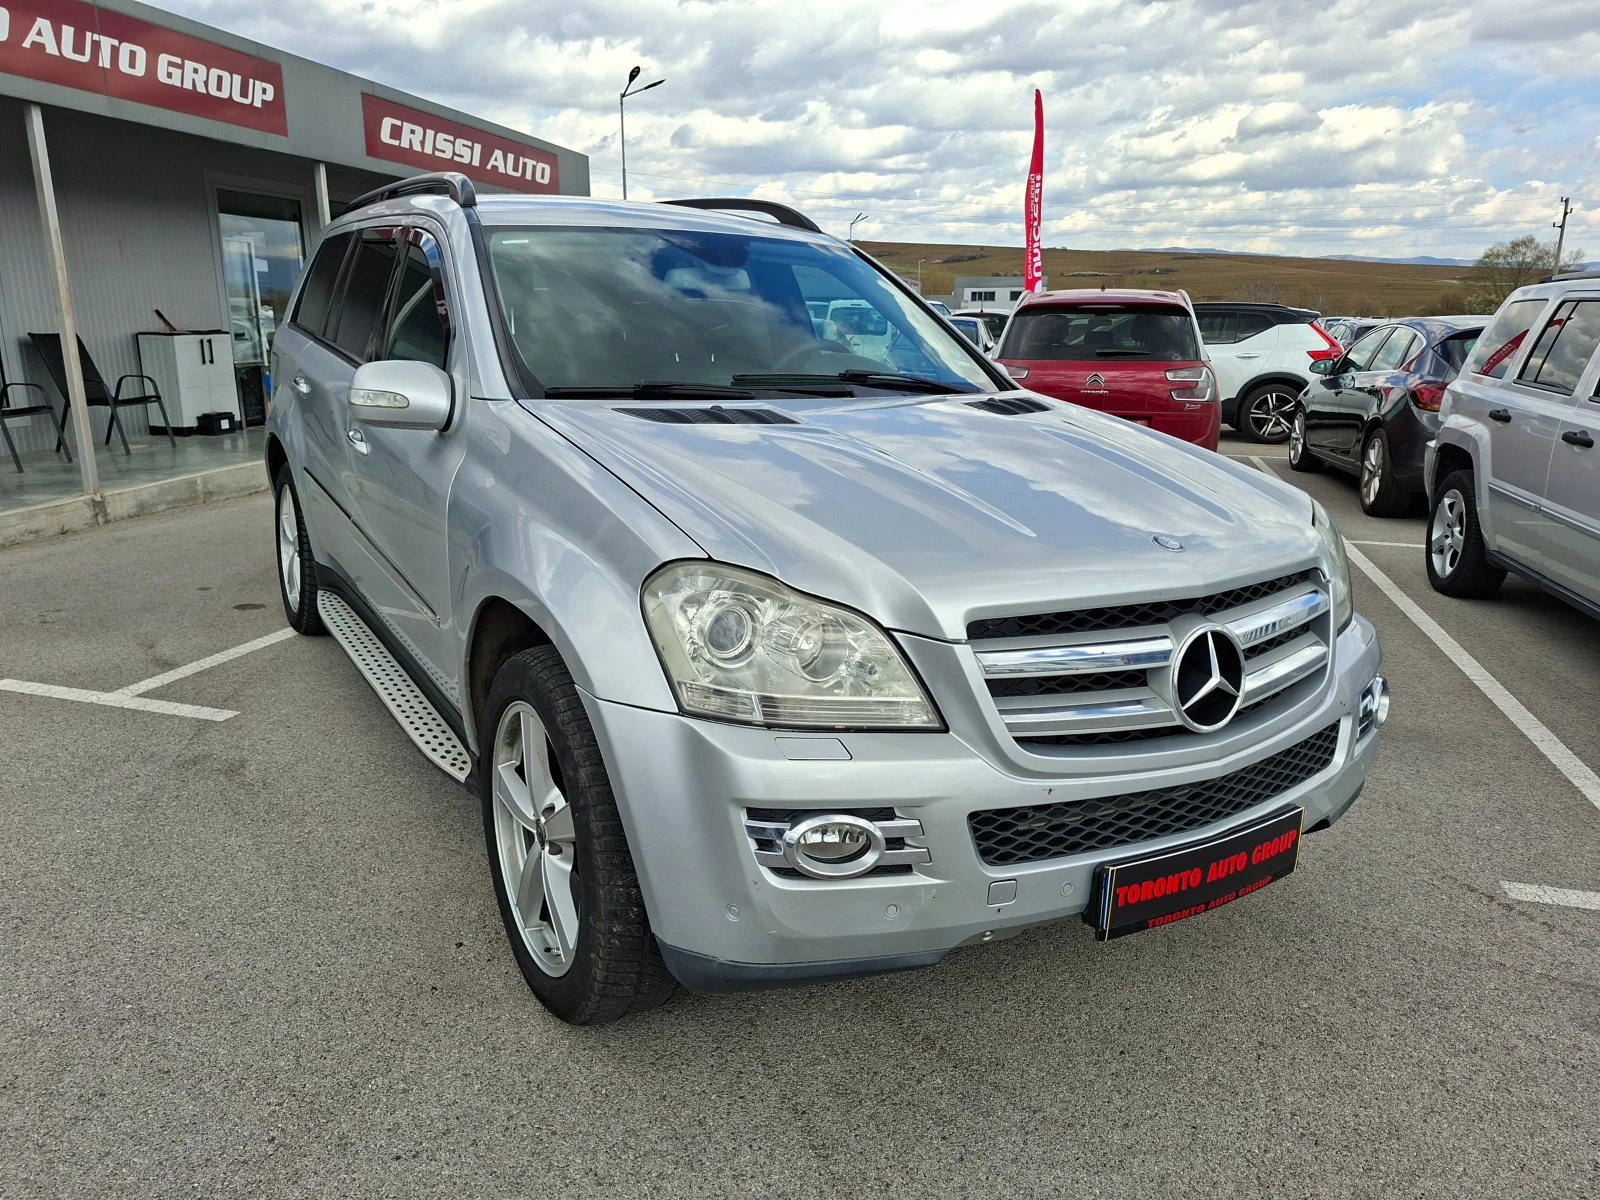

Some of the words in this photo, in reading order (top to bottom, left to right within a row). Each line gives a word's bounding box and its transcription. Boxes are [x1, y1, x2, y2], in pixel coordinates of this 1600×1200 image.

[22, 17, 147, 77] AUTO
[157, 53, 274, 108] GROUP
[380, 116, 481, 167] CRISSI
[486, 149, 551, 185] AUTO
[1116, 867, 1202, 907] TORONTO
[1206, 851, 1248, 884] AUTO
[1251, 829, 1297, 865] GROUP
[1147, 903, 1206, 929] TORONTO
[1207, 891, 1237, 910] AUTO
[1238, 875, 1272, 897] GROUP
